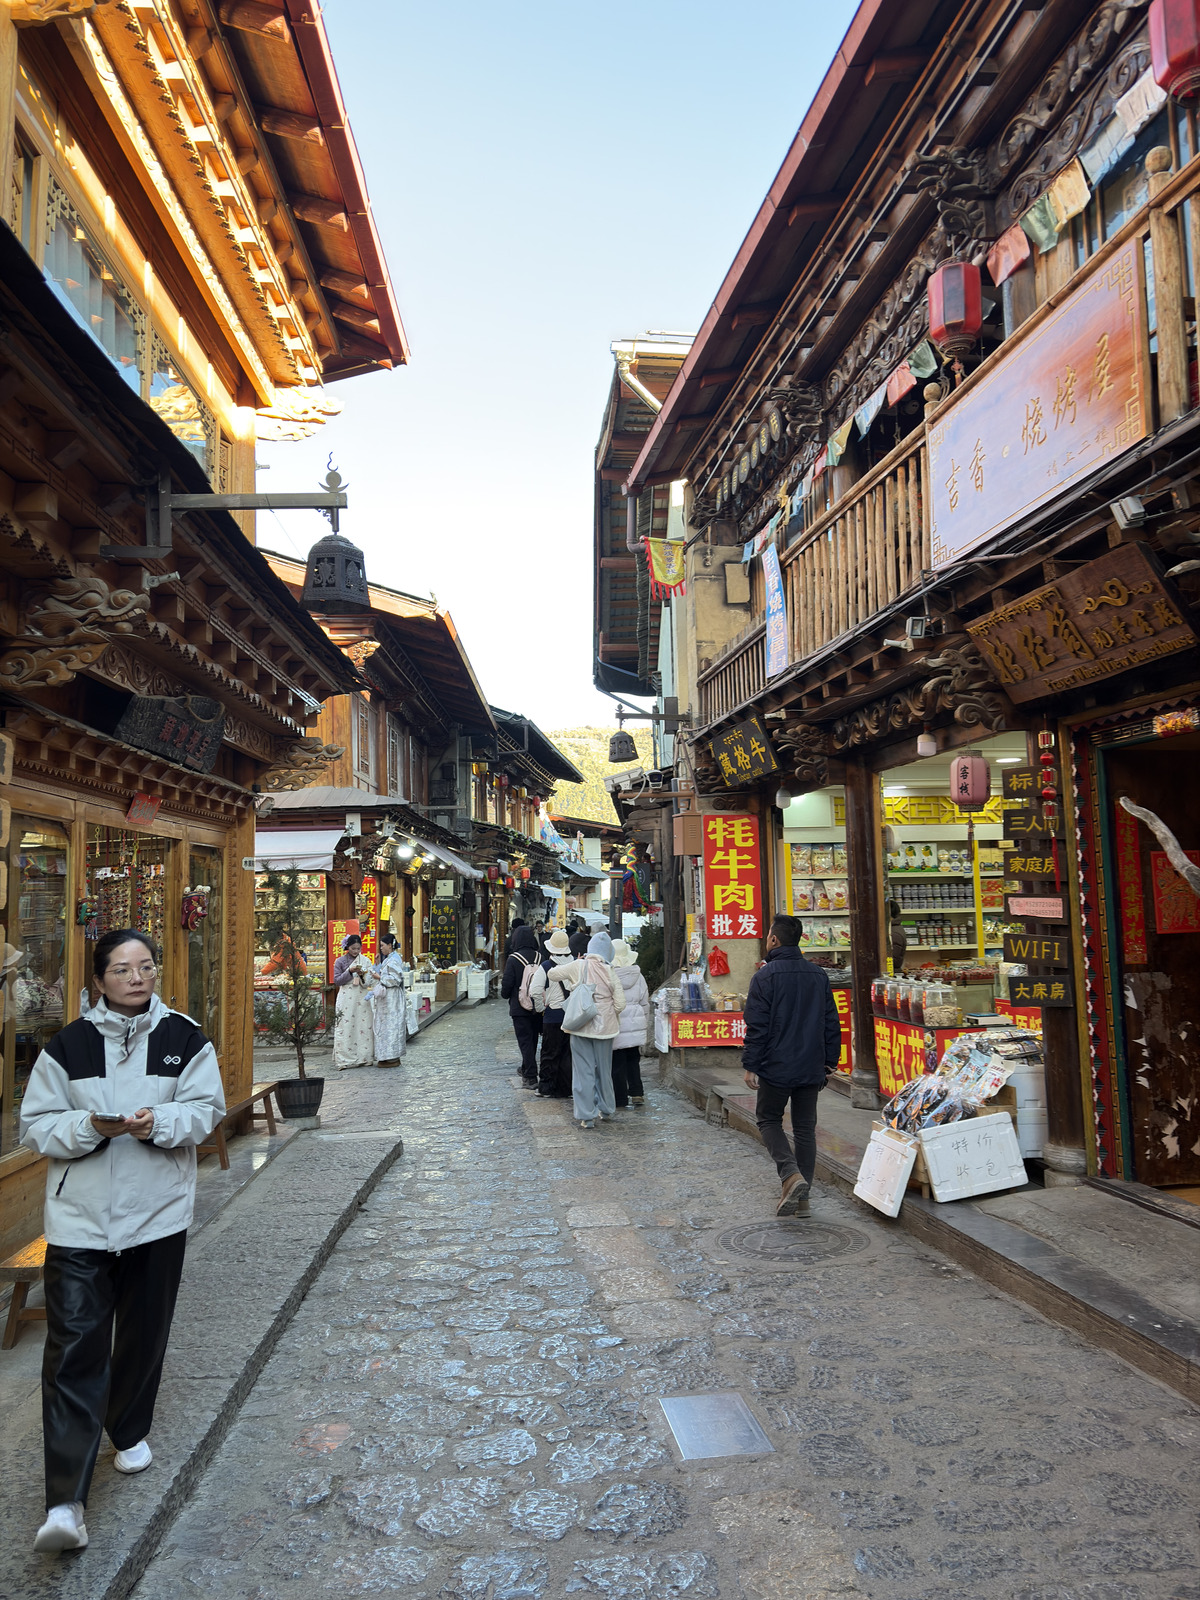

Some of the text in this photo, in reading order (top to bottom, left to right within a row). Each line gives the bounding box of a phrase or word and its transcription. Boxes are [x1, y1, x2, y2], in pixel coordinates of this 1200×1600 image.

[1043, 673, 1075, 690] Prayer
[1100, 654, 1130, 674] View
[1127, 633, 1196, 665] Guesthouse
[718, 736, 766, 777] 藏格牛
[706, 817, 757, 911] 牦牛肉
[1009, 856, 1057, 874] 家庭房
[711, 914, 758, 937] 批发
[1010, 939, 1060, 960] WIFI
[1014, 981, 1065, 1000] 大床房
[875, 1020, 926, 1095] 藏红花
[951, 1131, 993, 1155] 特价
